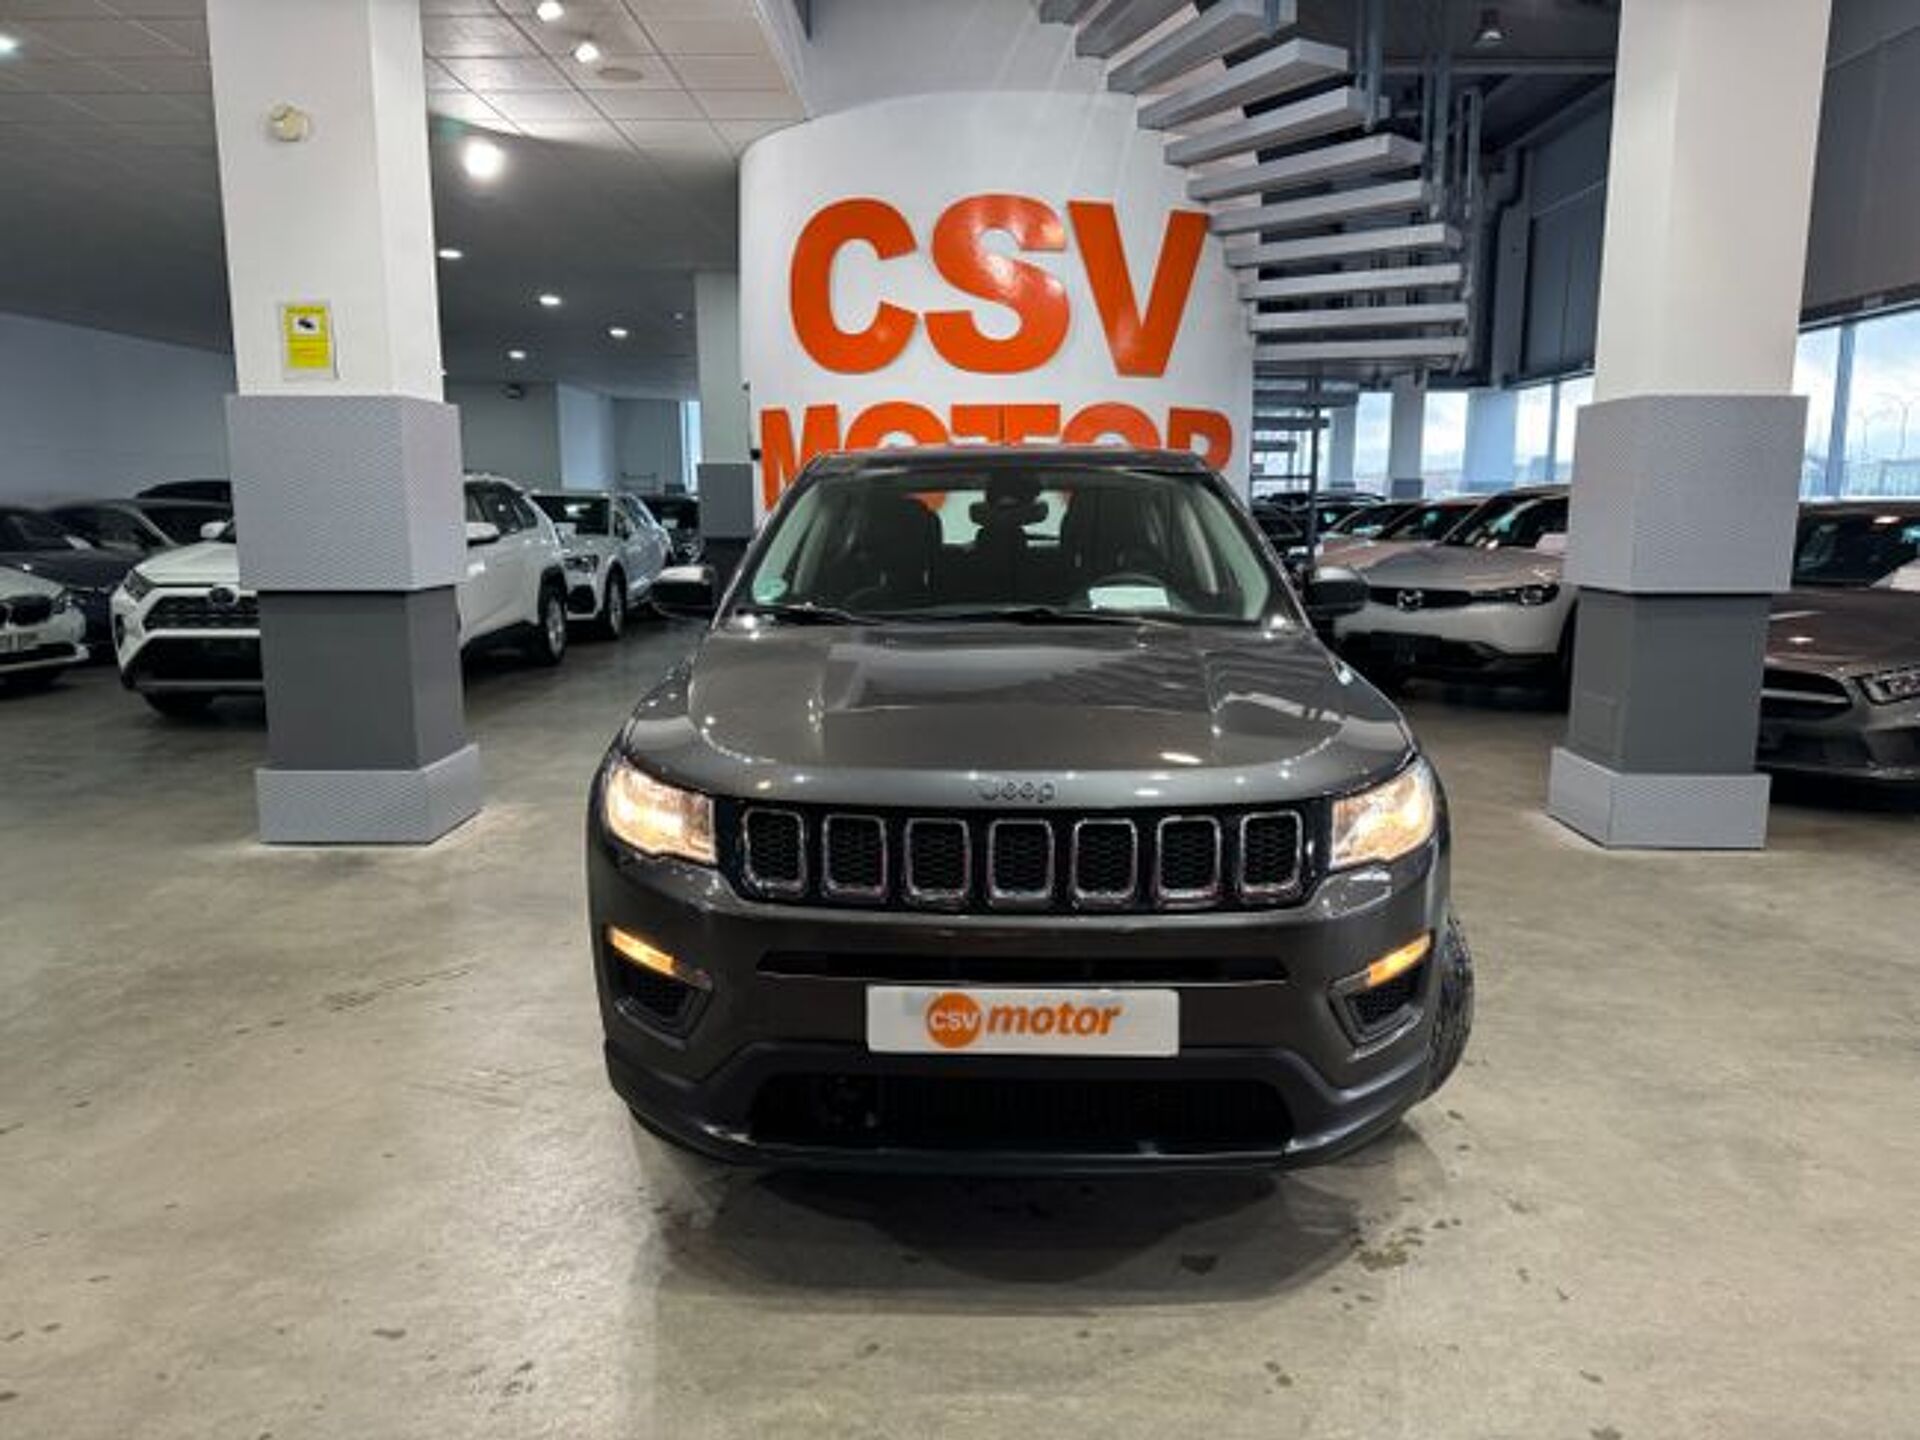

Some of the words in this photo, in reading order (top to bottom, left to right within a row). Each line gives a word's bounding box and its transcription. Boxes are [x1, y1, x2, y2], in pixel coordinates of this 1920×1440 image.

[790, 193, 1209, 377] CSV
[975, 779, 1055, 804] Jeep
[928, 1009, 979, 1031] CSV
[986, 1001, 1121, 1035] motor
